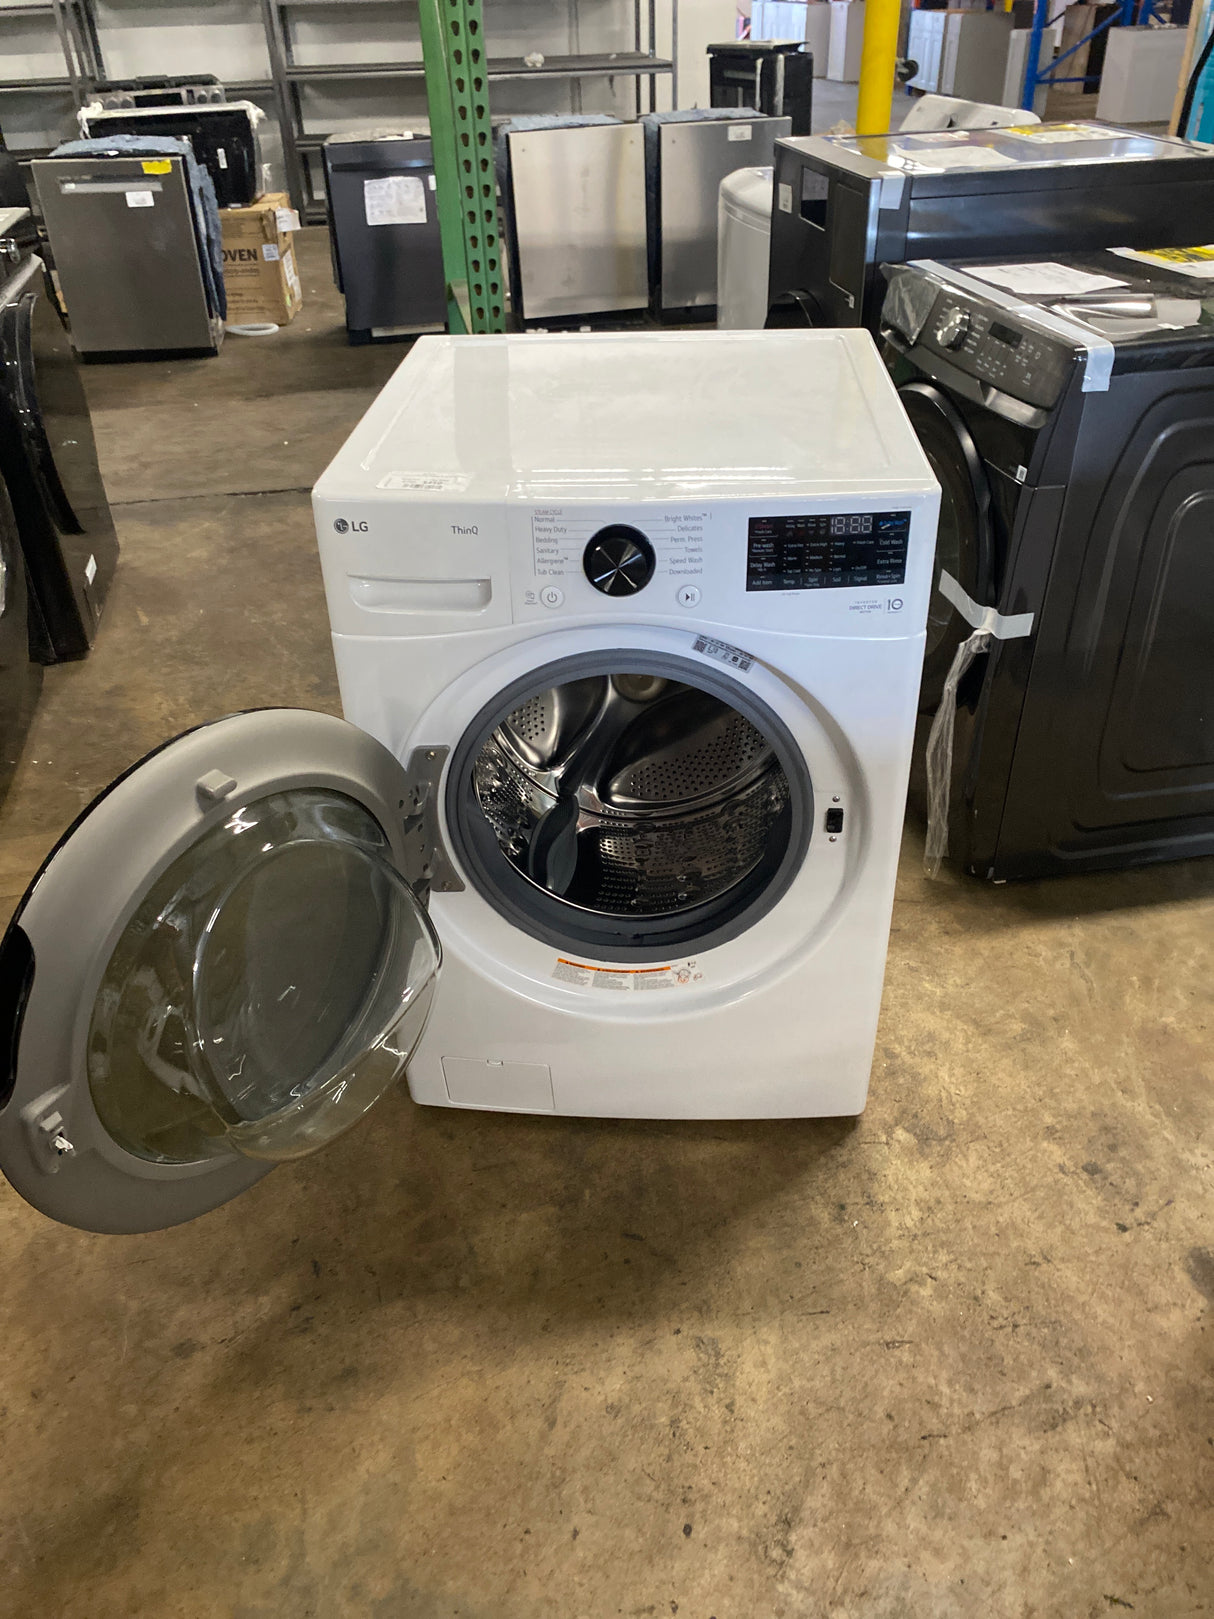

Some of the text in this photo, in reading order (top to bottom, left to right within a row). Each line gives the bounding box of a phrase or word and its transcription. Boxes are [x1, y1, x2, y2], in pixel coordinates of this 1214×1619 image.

[221, 248, 258, 263] OVEN
[664, 514, 682, 524] Bright
[352, 521, 369, 532] LG
[450, 525, 479, 535] ThinQ
[535, 526, 567, 534] Heavy Duty
[677, 525, 703, 533] Delicates
[687, 535, 703, 543] Press
[536, 547, 559, 555] Sanitary
[669, 556, 703, 565] Speed Wash
[537, 568, 565, 576] Tub Clean
[668, 567, 703, 576] Downloaded
